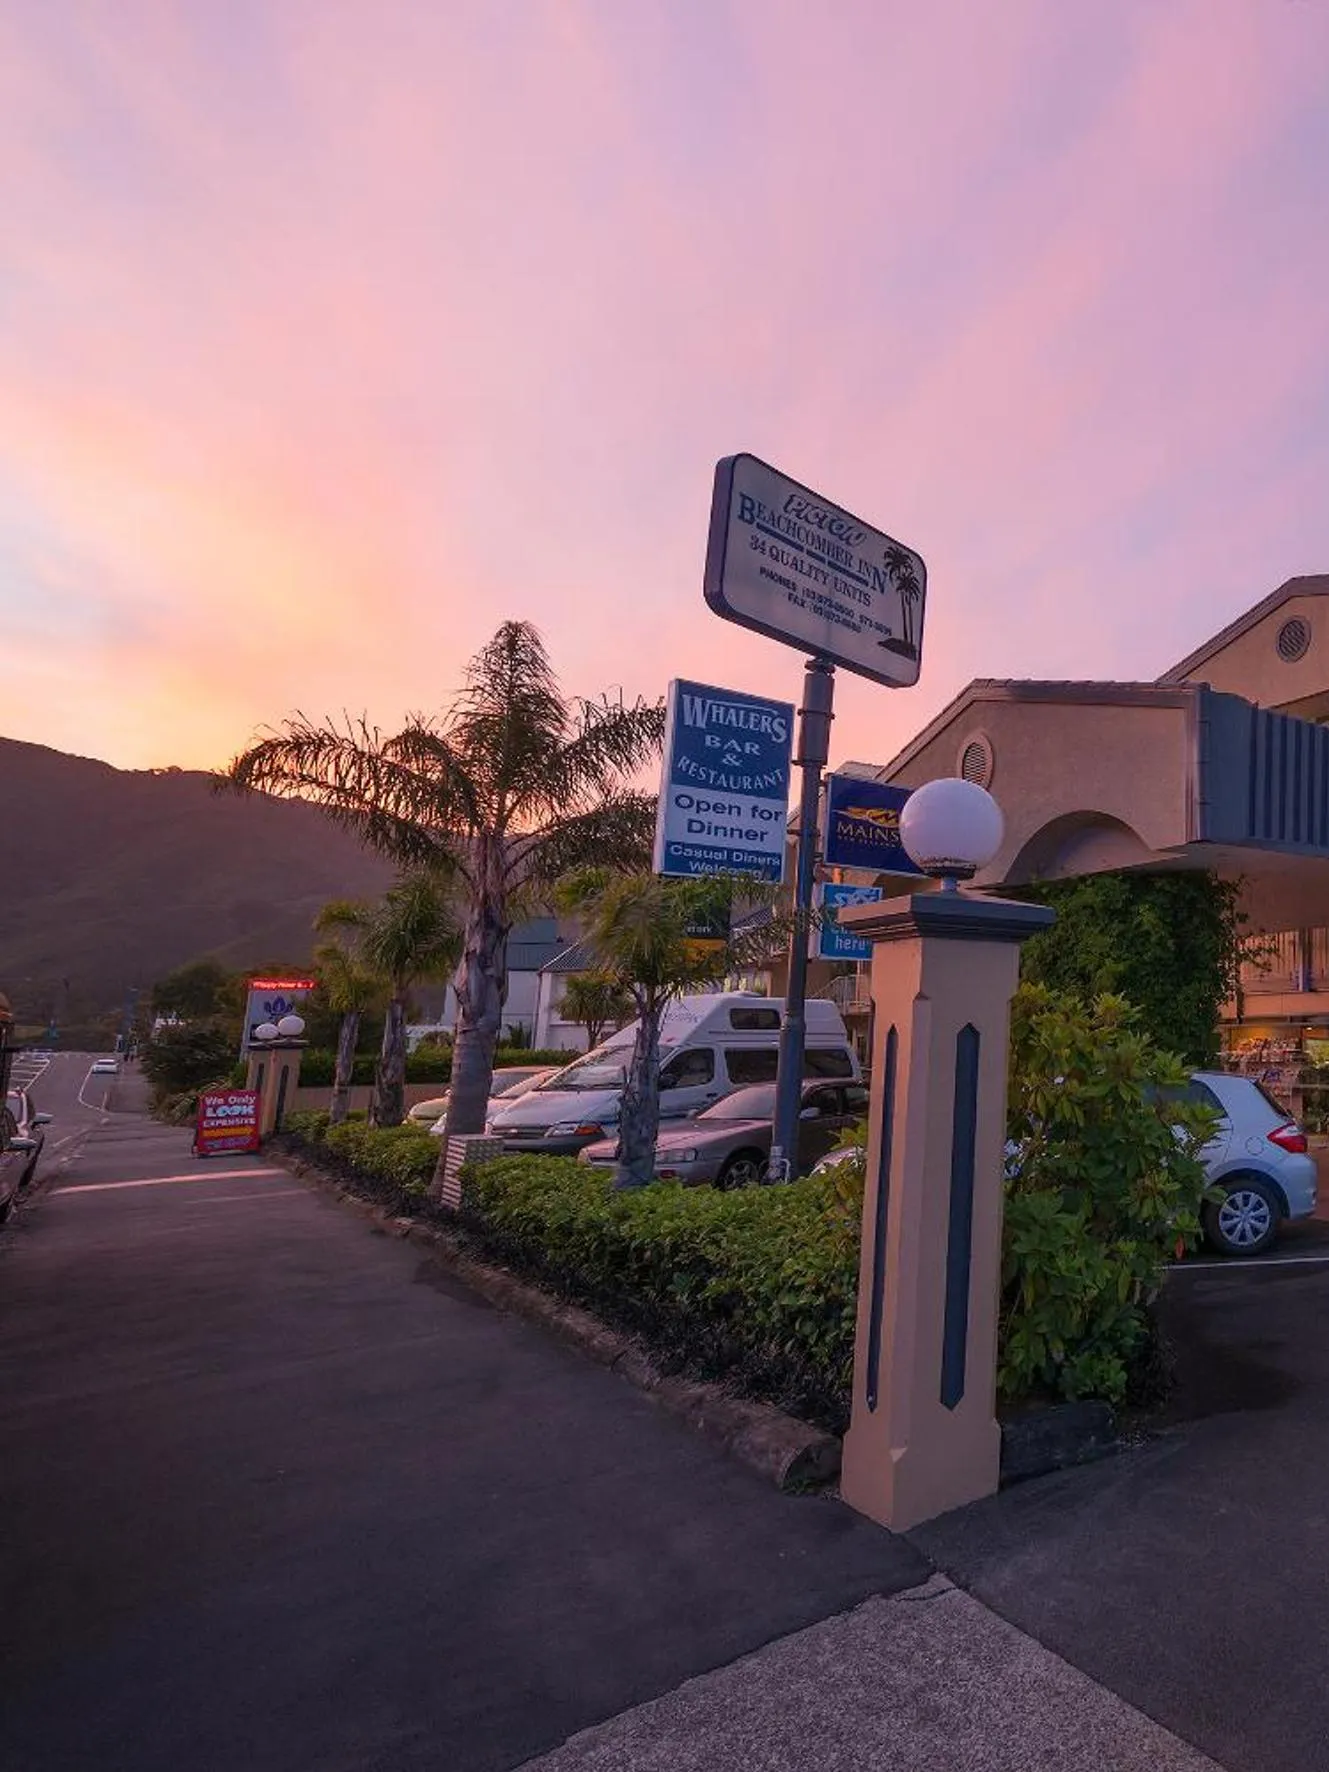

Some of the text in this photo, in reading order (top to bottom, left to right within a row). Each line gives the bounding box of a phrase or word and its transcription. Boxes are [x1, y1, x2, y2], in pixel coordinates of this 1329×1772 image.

[769, 545, 830, 586] QUALITY
[858, 558, 888, 594] INN
[682, 693, 788, 744] WHALERS
[704, 734, 762, 756] BAR
[721, 752, 744, 767] &
[677, 755, 784, 791] RESTAURANT
[674, 793, 783, 822] Open for
[687, 818, 769, 843] Dinner
[670, 844, 781, 866] Casual Diners
